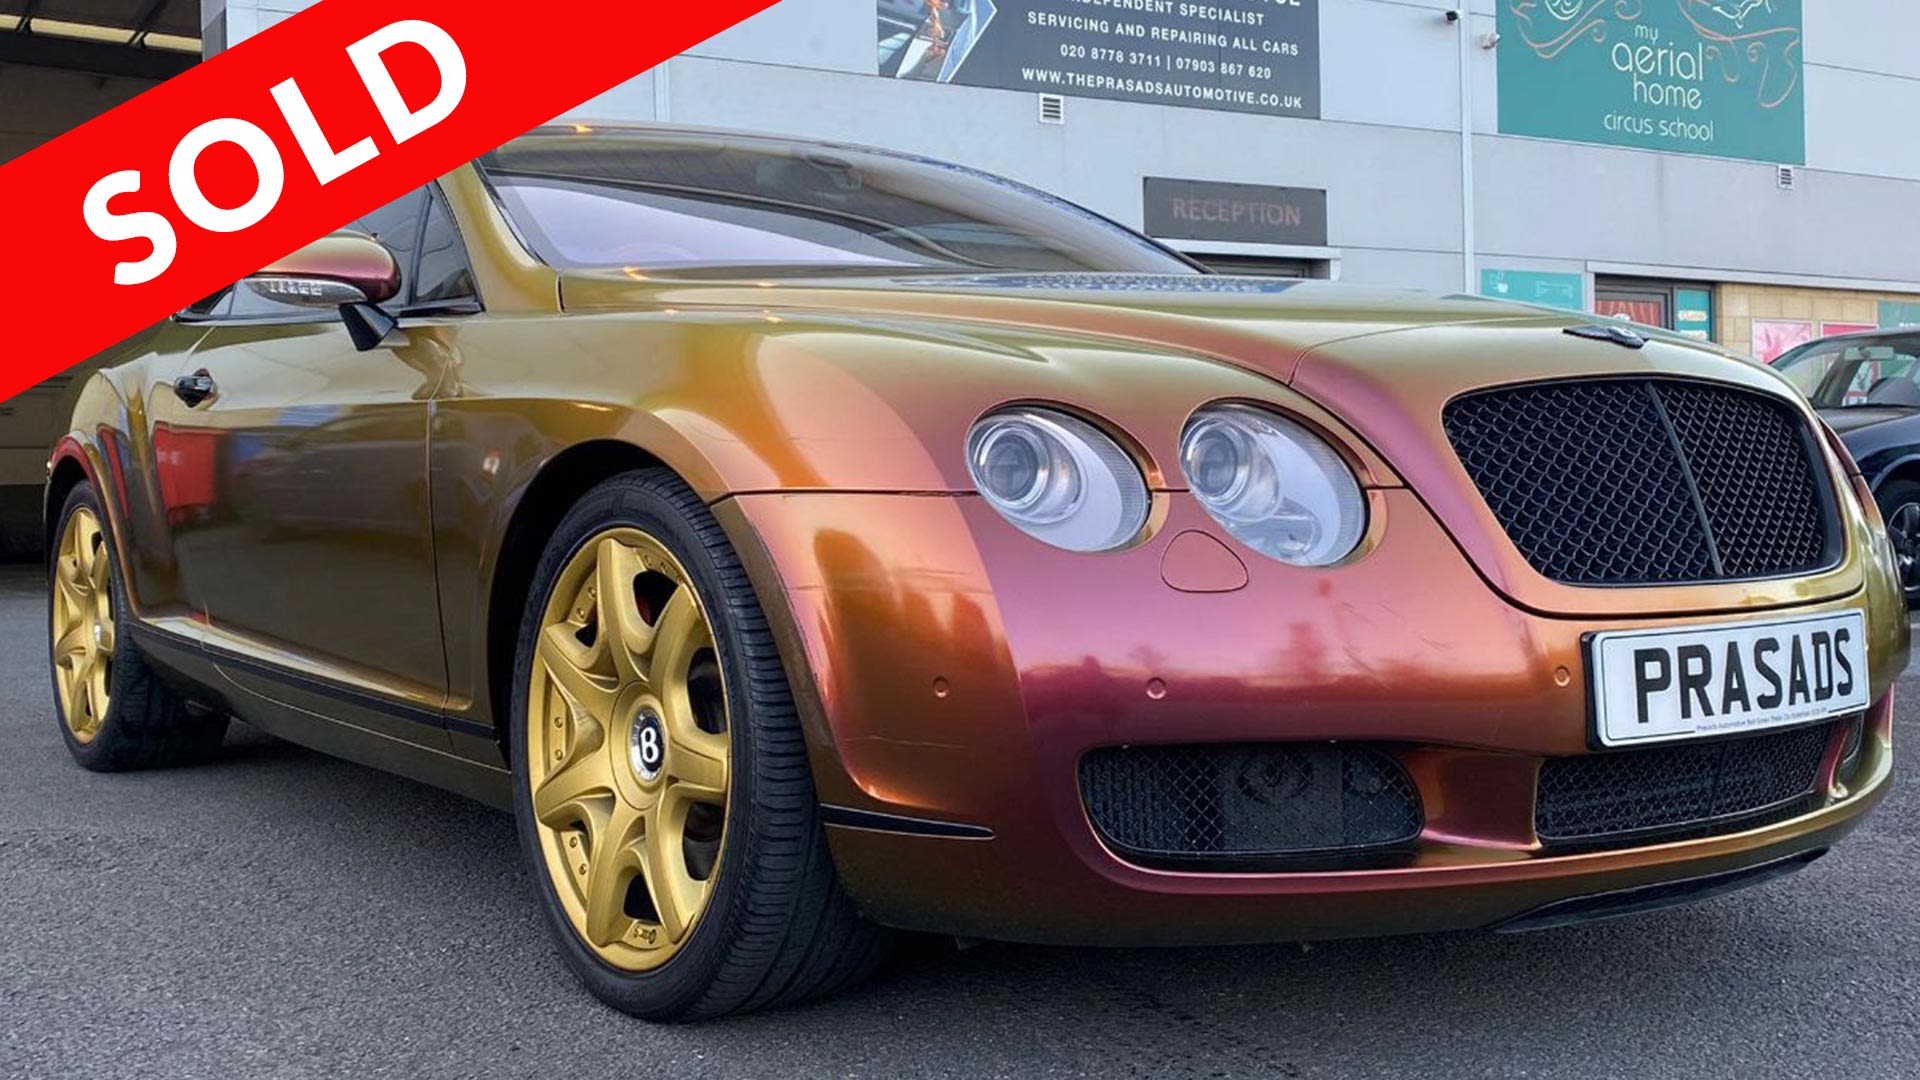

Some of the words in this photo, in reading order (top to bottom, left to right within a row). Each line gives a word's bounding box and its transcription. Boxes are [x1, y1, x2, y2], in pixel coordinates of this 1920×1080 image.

[1179, 3, 1264, 26] SPECIALIST
[1028, 11, 1109, 34] SERVICING
[1115, 23, 1145, 37] AND
[1151, 27, 1227, 48] REPAIRING
[1232, 37, 1258, 51] ALL
[1262, 40, 1299, 56] CARS
[1635, 24, 1658, 45] my
[1060, 44, 1085, 58] 020
[1091, 48, 1124, 63] 8778
[1129, 52, 1161, 67] 3711
[1176, 57, 1215, 73] 07903
[1220, 62, 1244, 76] 867
[1248, 65, 1271, 79] 620
[1612, 41, 1703, 81] aerial
[1022, 68, 1302, 108] WWW.THEPRASADSAUTOMOTIVE.CO.UK
[1633, 72, 1702, 109] home
[1604, 110, 1653, 134] circus
[1659, 115, 1714, 141] school
[1172, 197, 1301, 226] RECEPTION
[1633, 628, 1853, 723] PRASADS
